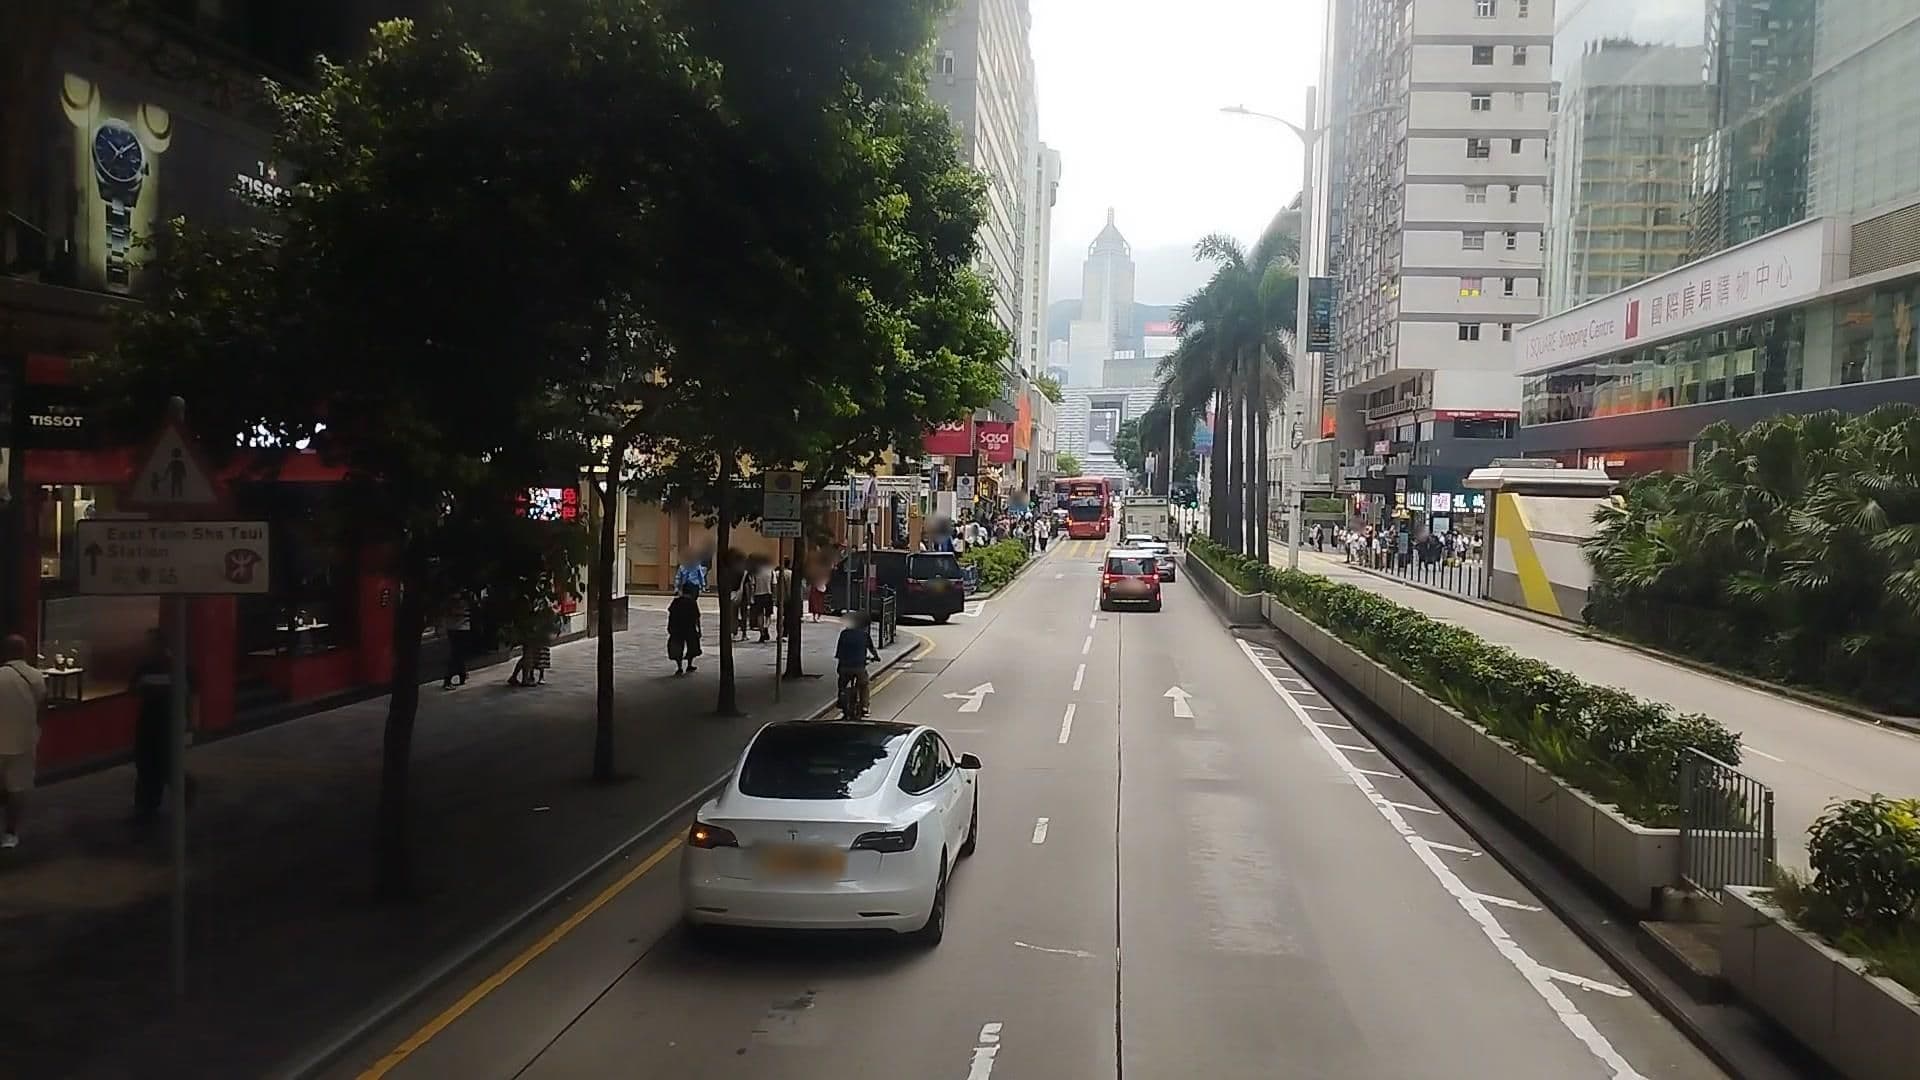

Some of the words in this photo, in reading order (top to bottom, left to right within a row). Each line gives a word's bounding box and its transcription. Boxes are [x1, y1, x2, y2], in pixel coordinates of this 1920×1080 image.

[1559, 327, 1588, 350] Shopping
[1589, 319, 1615, 340] Centre
[29, 415, 84, 428] TISSOT
[107, 527, 143, 541] East
[191, 527, 223, 540] Sha
[229, 526, 263, 540] Tsui
[107, 543, 169, 558] Station
